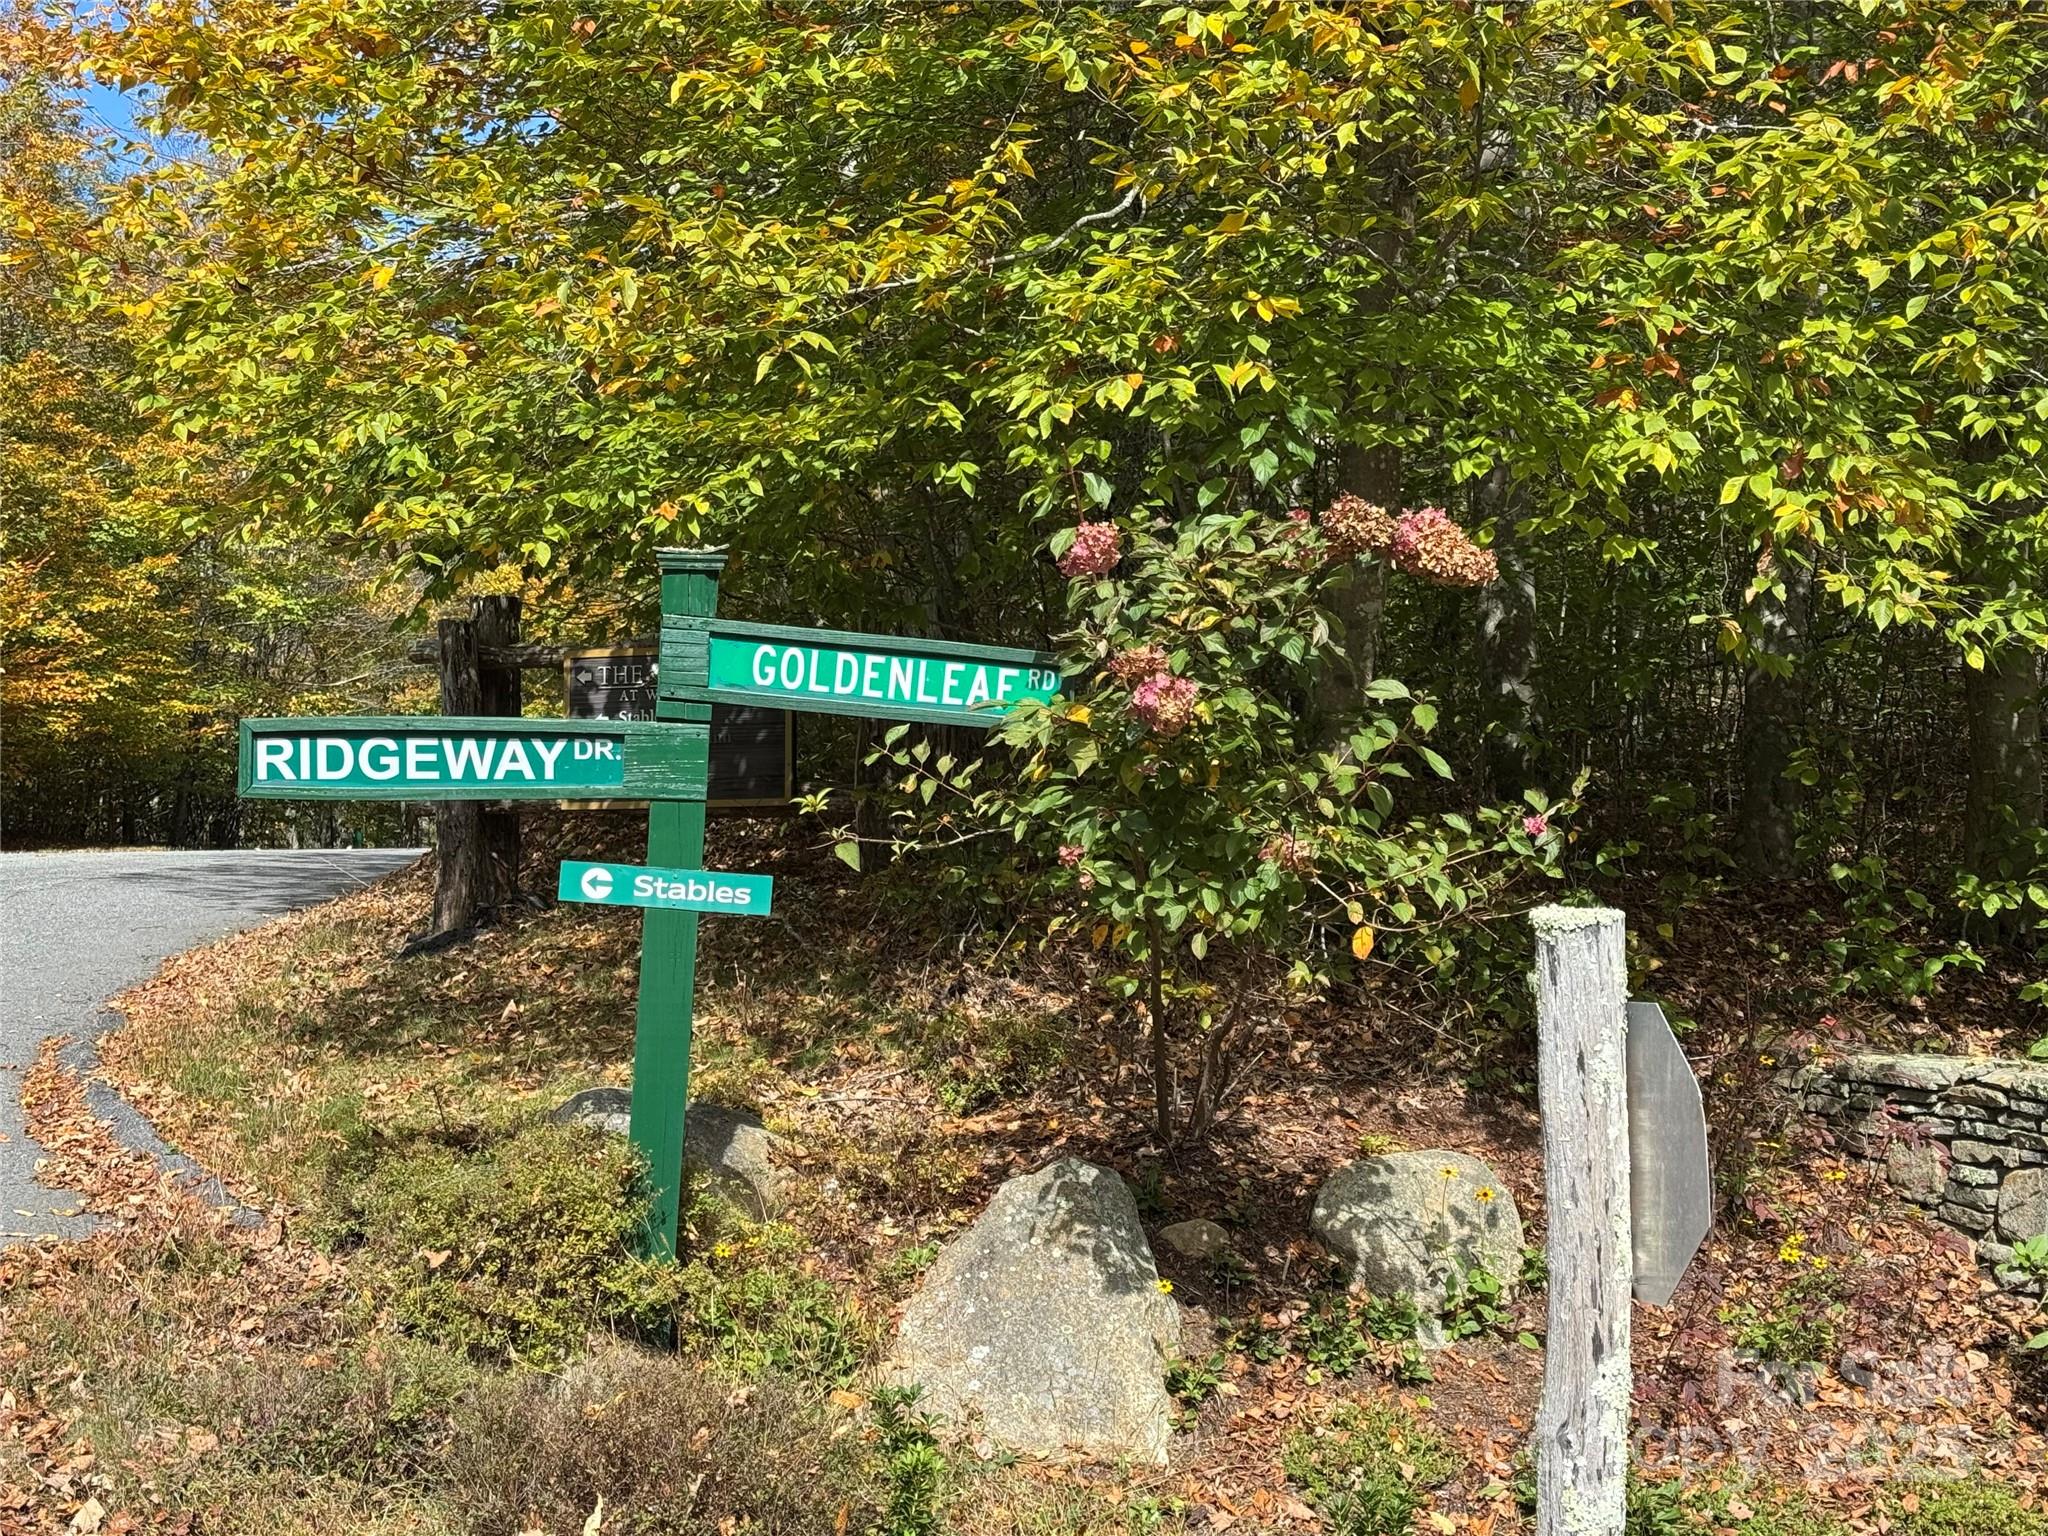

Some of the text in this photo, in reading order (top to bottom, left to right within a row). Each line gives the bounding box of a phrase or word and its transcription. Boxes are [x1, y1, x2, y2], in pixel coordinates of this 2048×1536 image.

[597, 665, 642, 685] THE
[752, 645, 1055, 705] GOLDENLEAF RD
[620, 689, 639, 701] AT
[619, 710, 657, 721] Stabl
[256, 737, 621, 780] RIDGEWAY DR.
[633, 874, 752, 905] Stables
